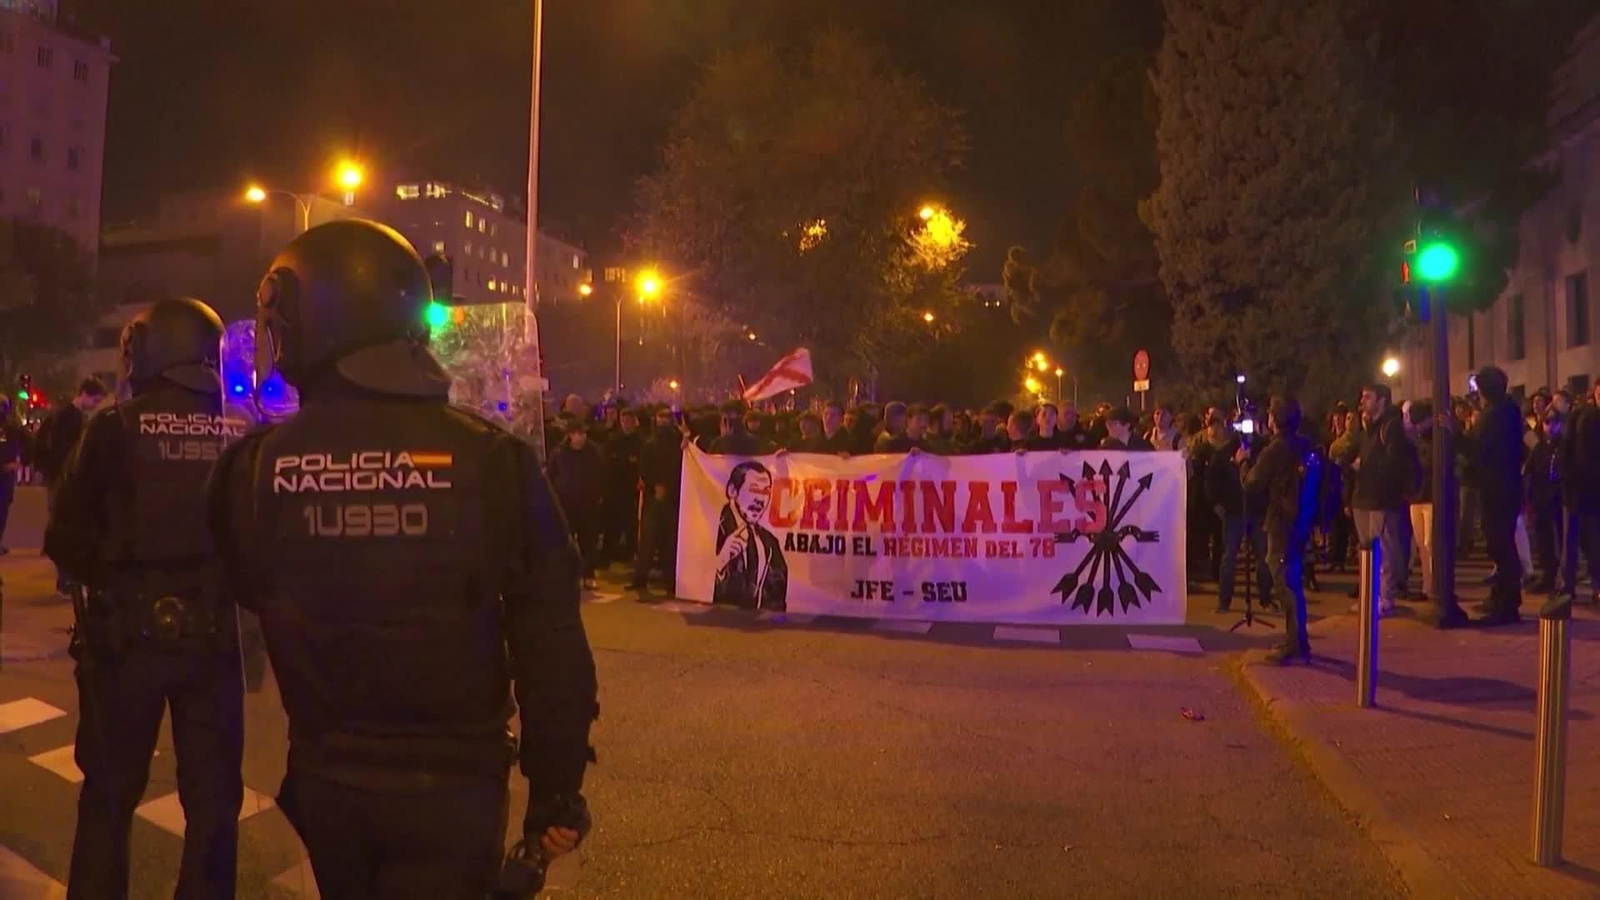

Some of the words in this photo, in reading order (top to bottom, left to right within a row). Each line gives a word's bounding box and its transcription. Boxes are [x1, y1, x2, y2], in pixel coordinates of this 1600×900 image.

[139, 413, 225, 425] POLICIA
[140, 423, 246, 437] NACIONAL
[275, 452, 415, 474] POLICIA
[273, 470, 452, 493] NACIONAL
[768, 478, 1107, 534] CRIMINALES
[304, 504, 428, 536] 1U930
[785, 532, 846, 555] ABAJO
[852, 537, 877, 556] EL
[985, 540, 1024, 559] DEL
[1029, 538, 1056, 558] 78
[850, 580, 894, 601] JFE
[921, 581, 967, 602] SEU
